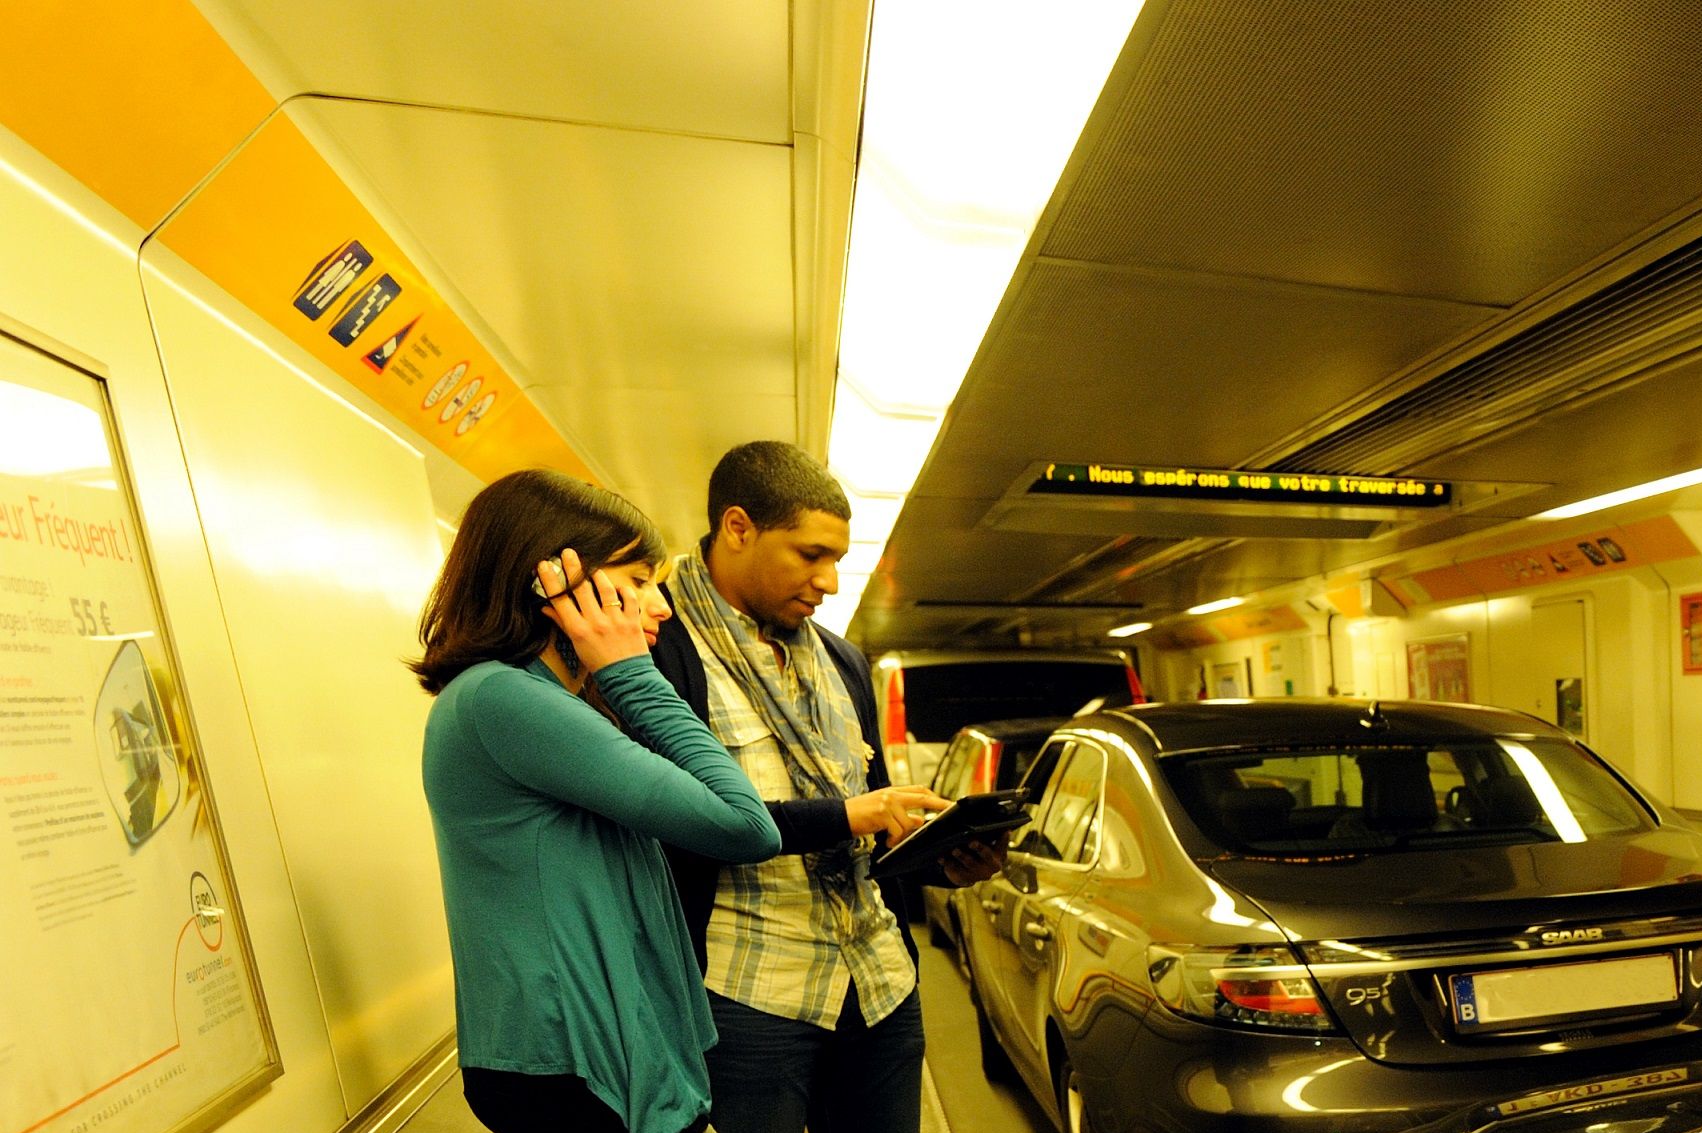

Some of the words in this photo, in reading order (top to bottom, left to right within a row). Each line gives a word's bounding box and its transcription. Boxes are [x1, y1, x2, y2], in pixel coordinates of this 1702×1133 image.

[1088, 465, 1134, 483] Nous
[1143, 468, 1230, 488] espérons
[1238, 475, 1271, 489] que
[1279, 475, 1331, 491] votre
[1339, 477, 1426, 495] traversée
[28, 494, 124, 569] Fréquent
[1541, 927, 1603, 945] SAAB
[1460, 1003, 1475, 1021] B
[91, 1093, 135, 1128] CROSSING
[153, 1062, 187, 1089] CHANNEL
